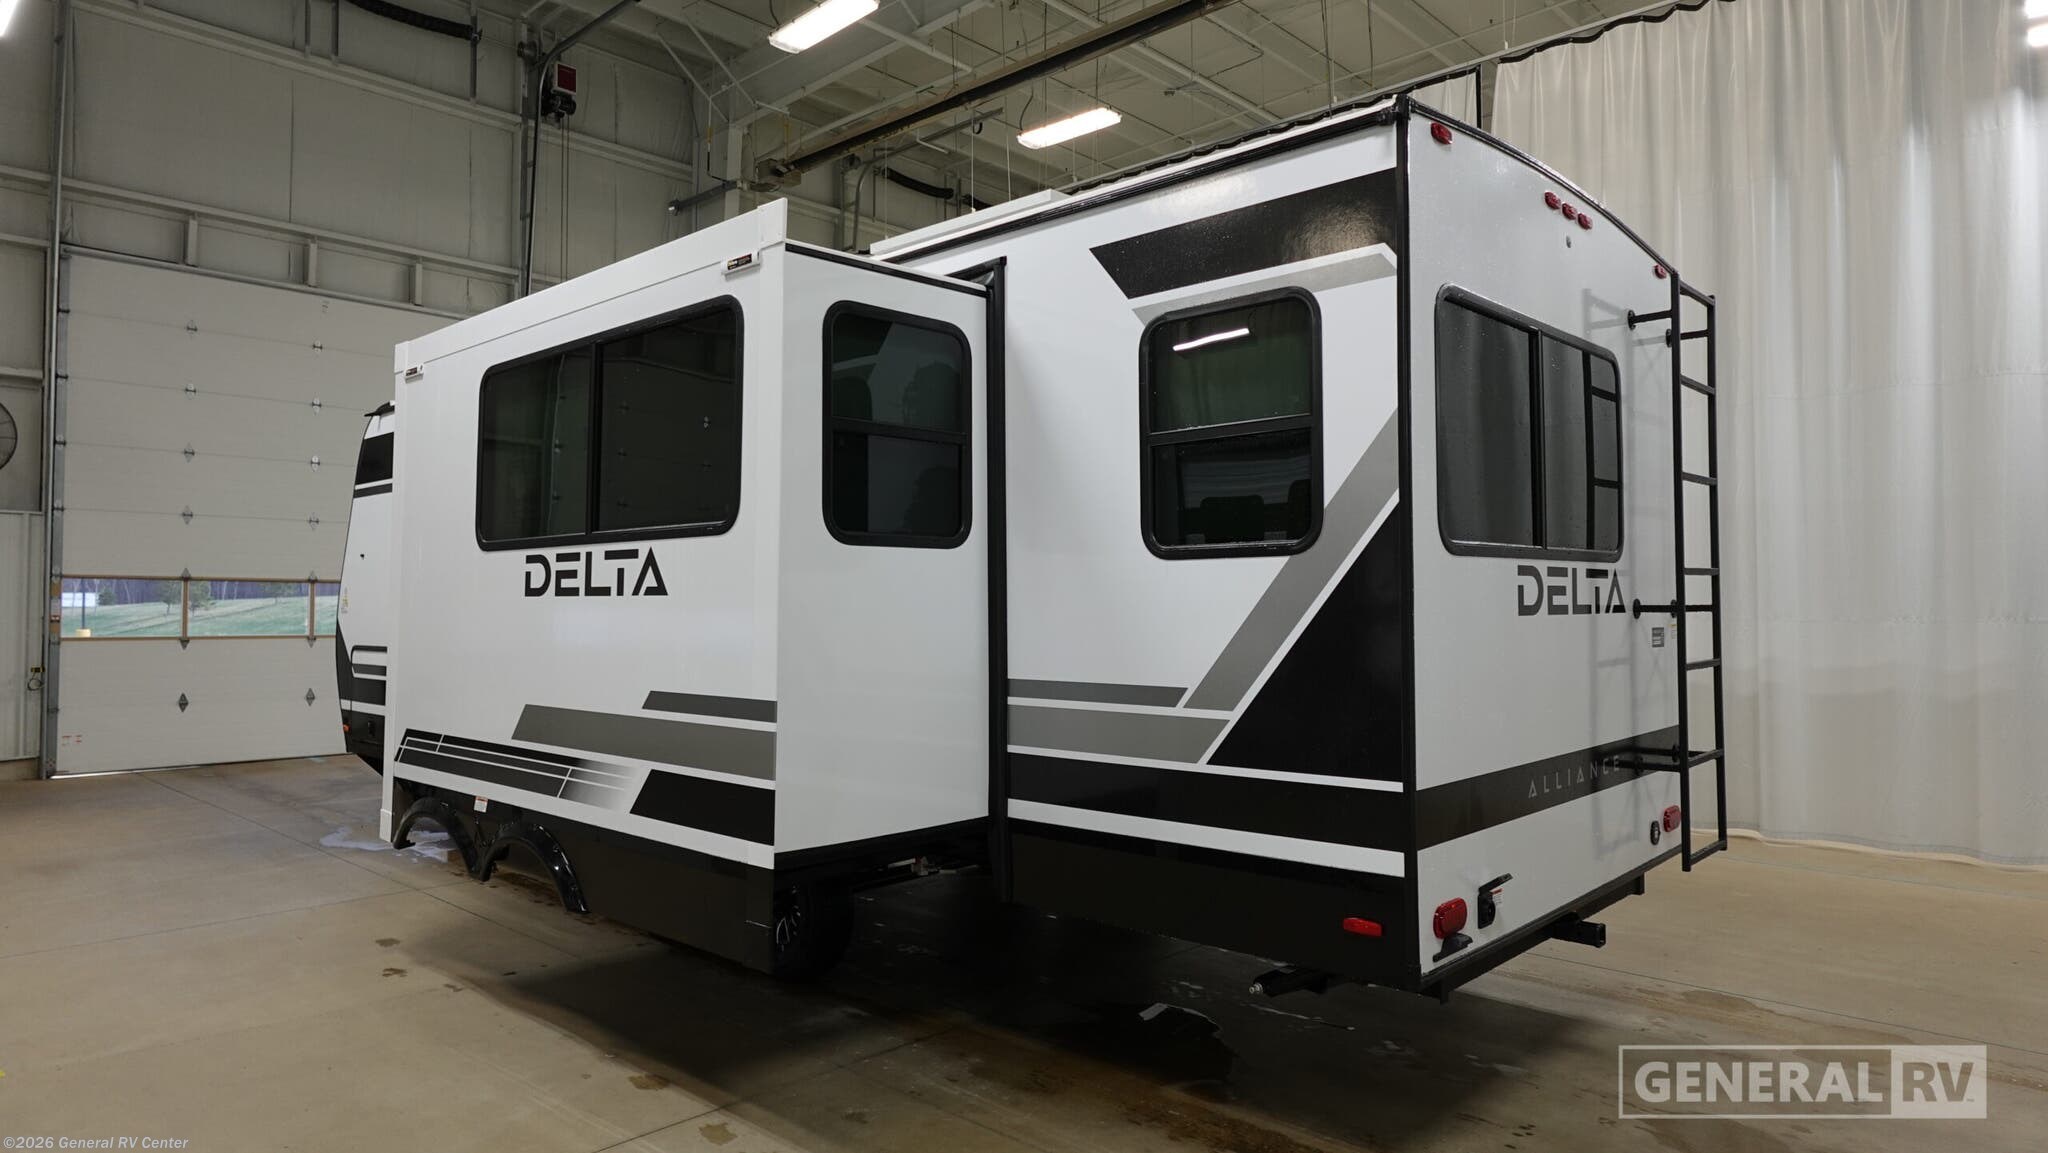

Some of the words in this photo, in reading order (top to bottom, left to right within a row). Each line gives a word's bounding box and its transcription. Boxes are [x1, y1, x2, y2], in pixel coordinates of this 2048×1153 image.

[525, 546, 668, 597] DELTA
[1517, 564, 1626, 616] DELTA
[1528, 755, 1620, 799] ALLIANCE
